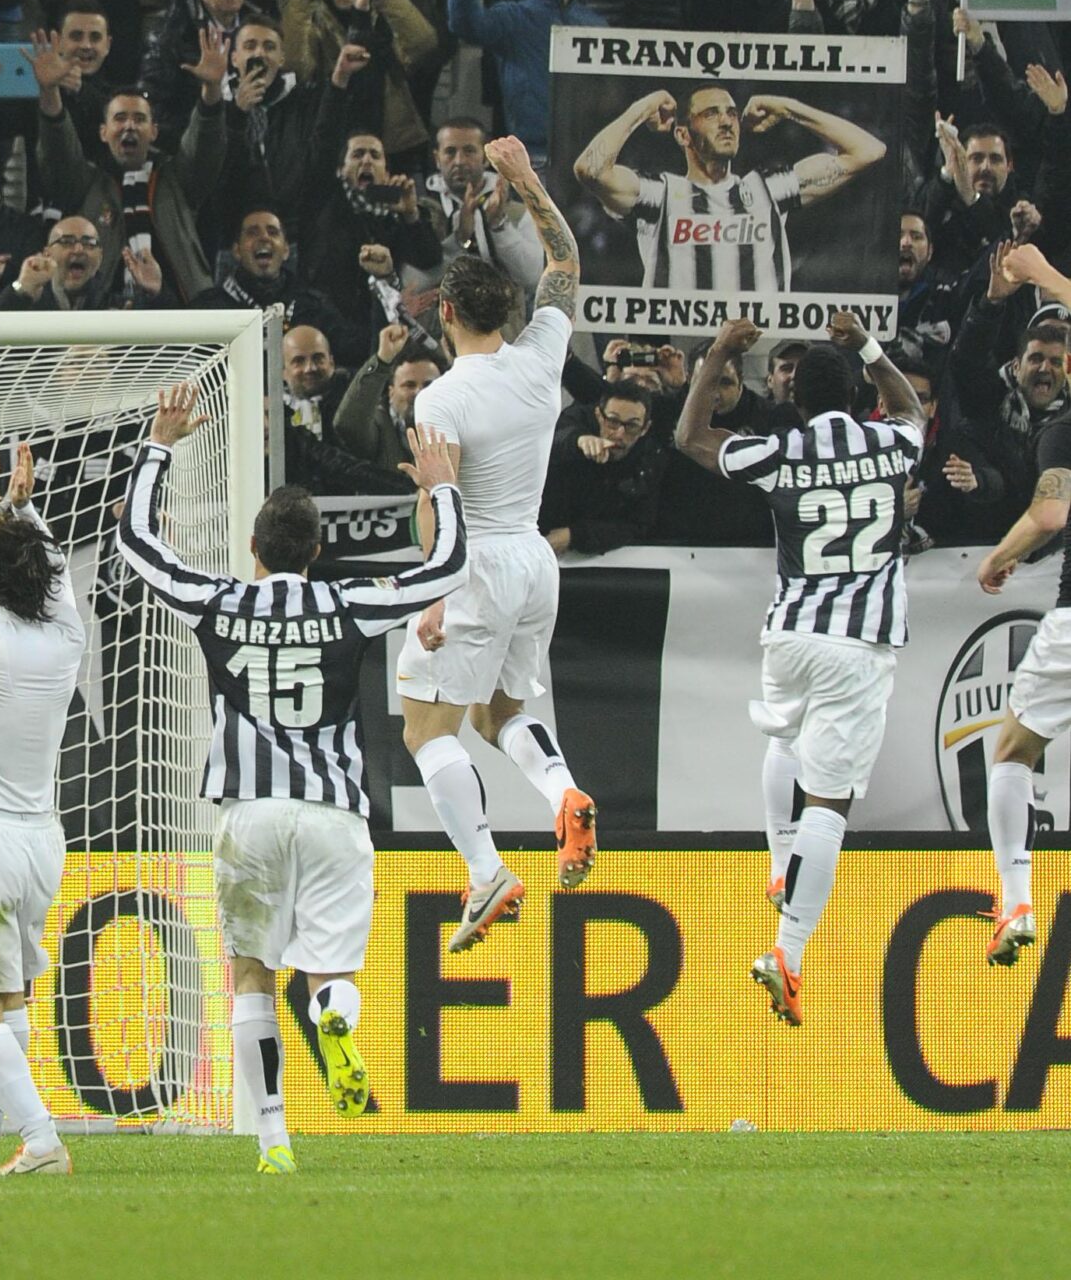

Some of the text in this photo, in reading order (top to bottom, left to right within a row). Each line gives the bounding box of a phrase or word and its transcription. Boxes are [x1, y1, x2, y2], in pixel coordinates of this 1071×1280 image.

[572, 37, 887, 77] TRANQUILLI...
[673, 214, 768, 245] Betclic
[583, 296, 617, 323] CI
[625, 298, 729, 328] PENSA
[778, 449, 905, 489] ASAMOAH
[321, 506, 398, 543] TUS
[798, 482, 896, 575] 22
[215, 614, 343, 645] BARZAGLI
[225, 645, 325, 728] 15
[954, 683, 1014, 723] JUV
